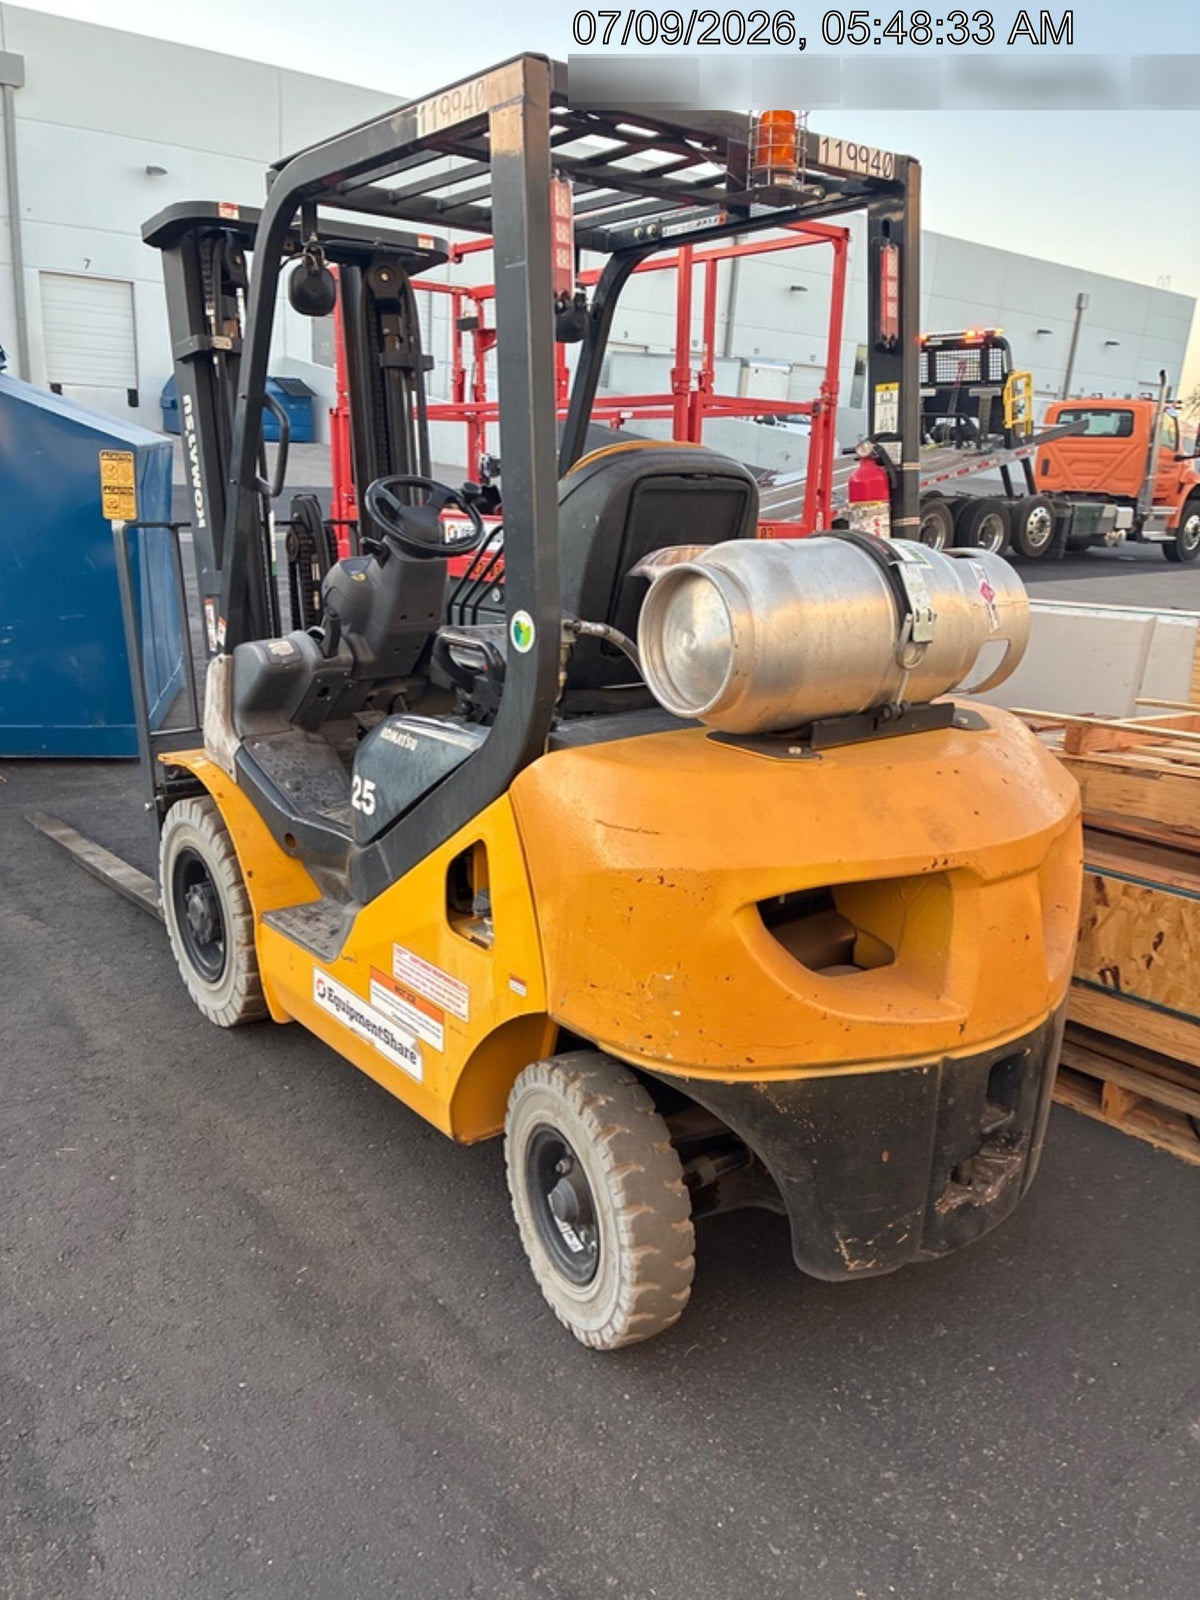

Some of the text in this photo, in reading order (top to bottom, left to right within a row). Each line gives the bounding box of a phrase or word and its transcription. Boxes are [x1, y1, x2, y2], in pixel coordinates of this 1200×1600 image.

[821, 137, 894, 178] 119940
[83, 257, 91, 270] 7
[182, 394, 206, 528] KOMATSU
[352, 775, 376, 816] 25
[327, 987, 418, 1066] EquipmentShare
